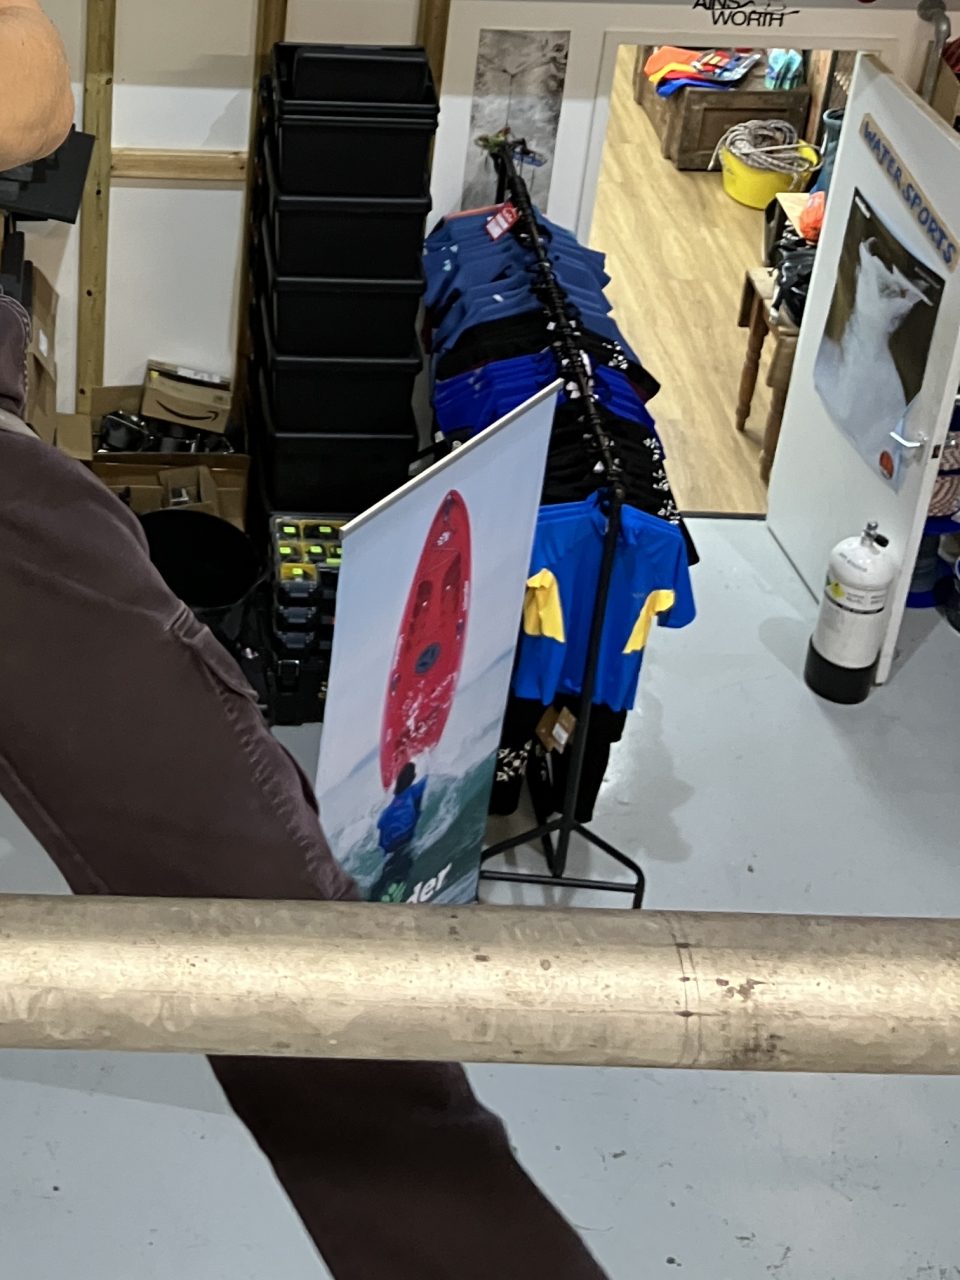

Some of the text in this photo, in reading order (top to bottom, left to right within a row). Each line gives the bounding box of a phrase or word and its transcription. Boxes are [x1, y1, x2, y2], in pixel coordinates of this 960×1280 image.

[711, 10, 788, 28] WORTH
[863, 121, 957, 264] WATER SPORTS
